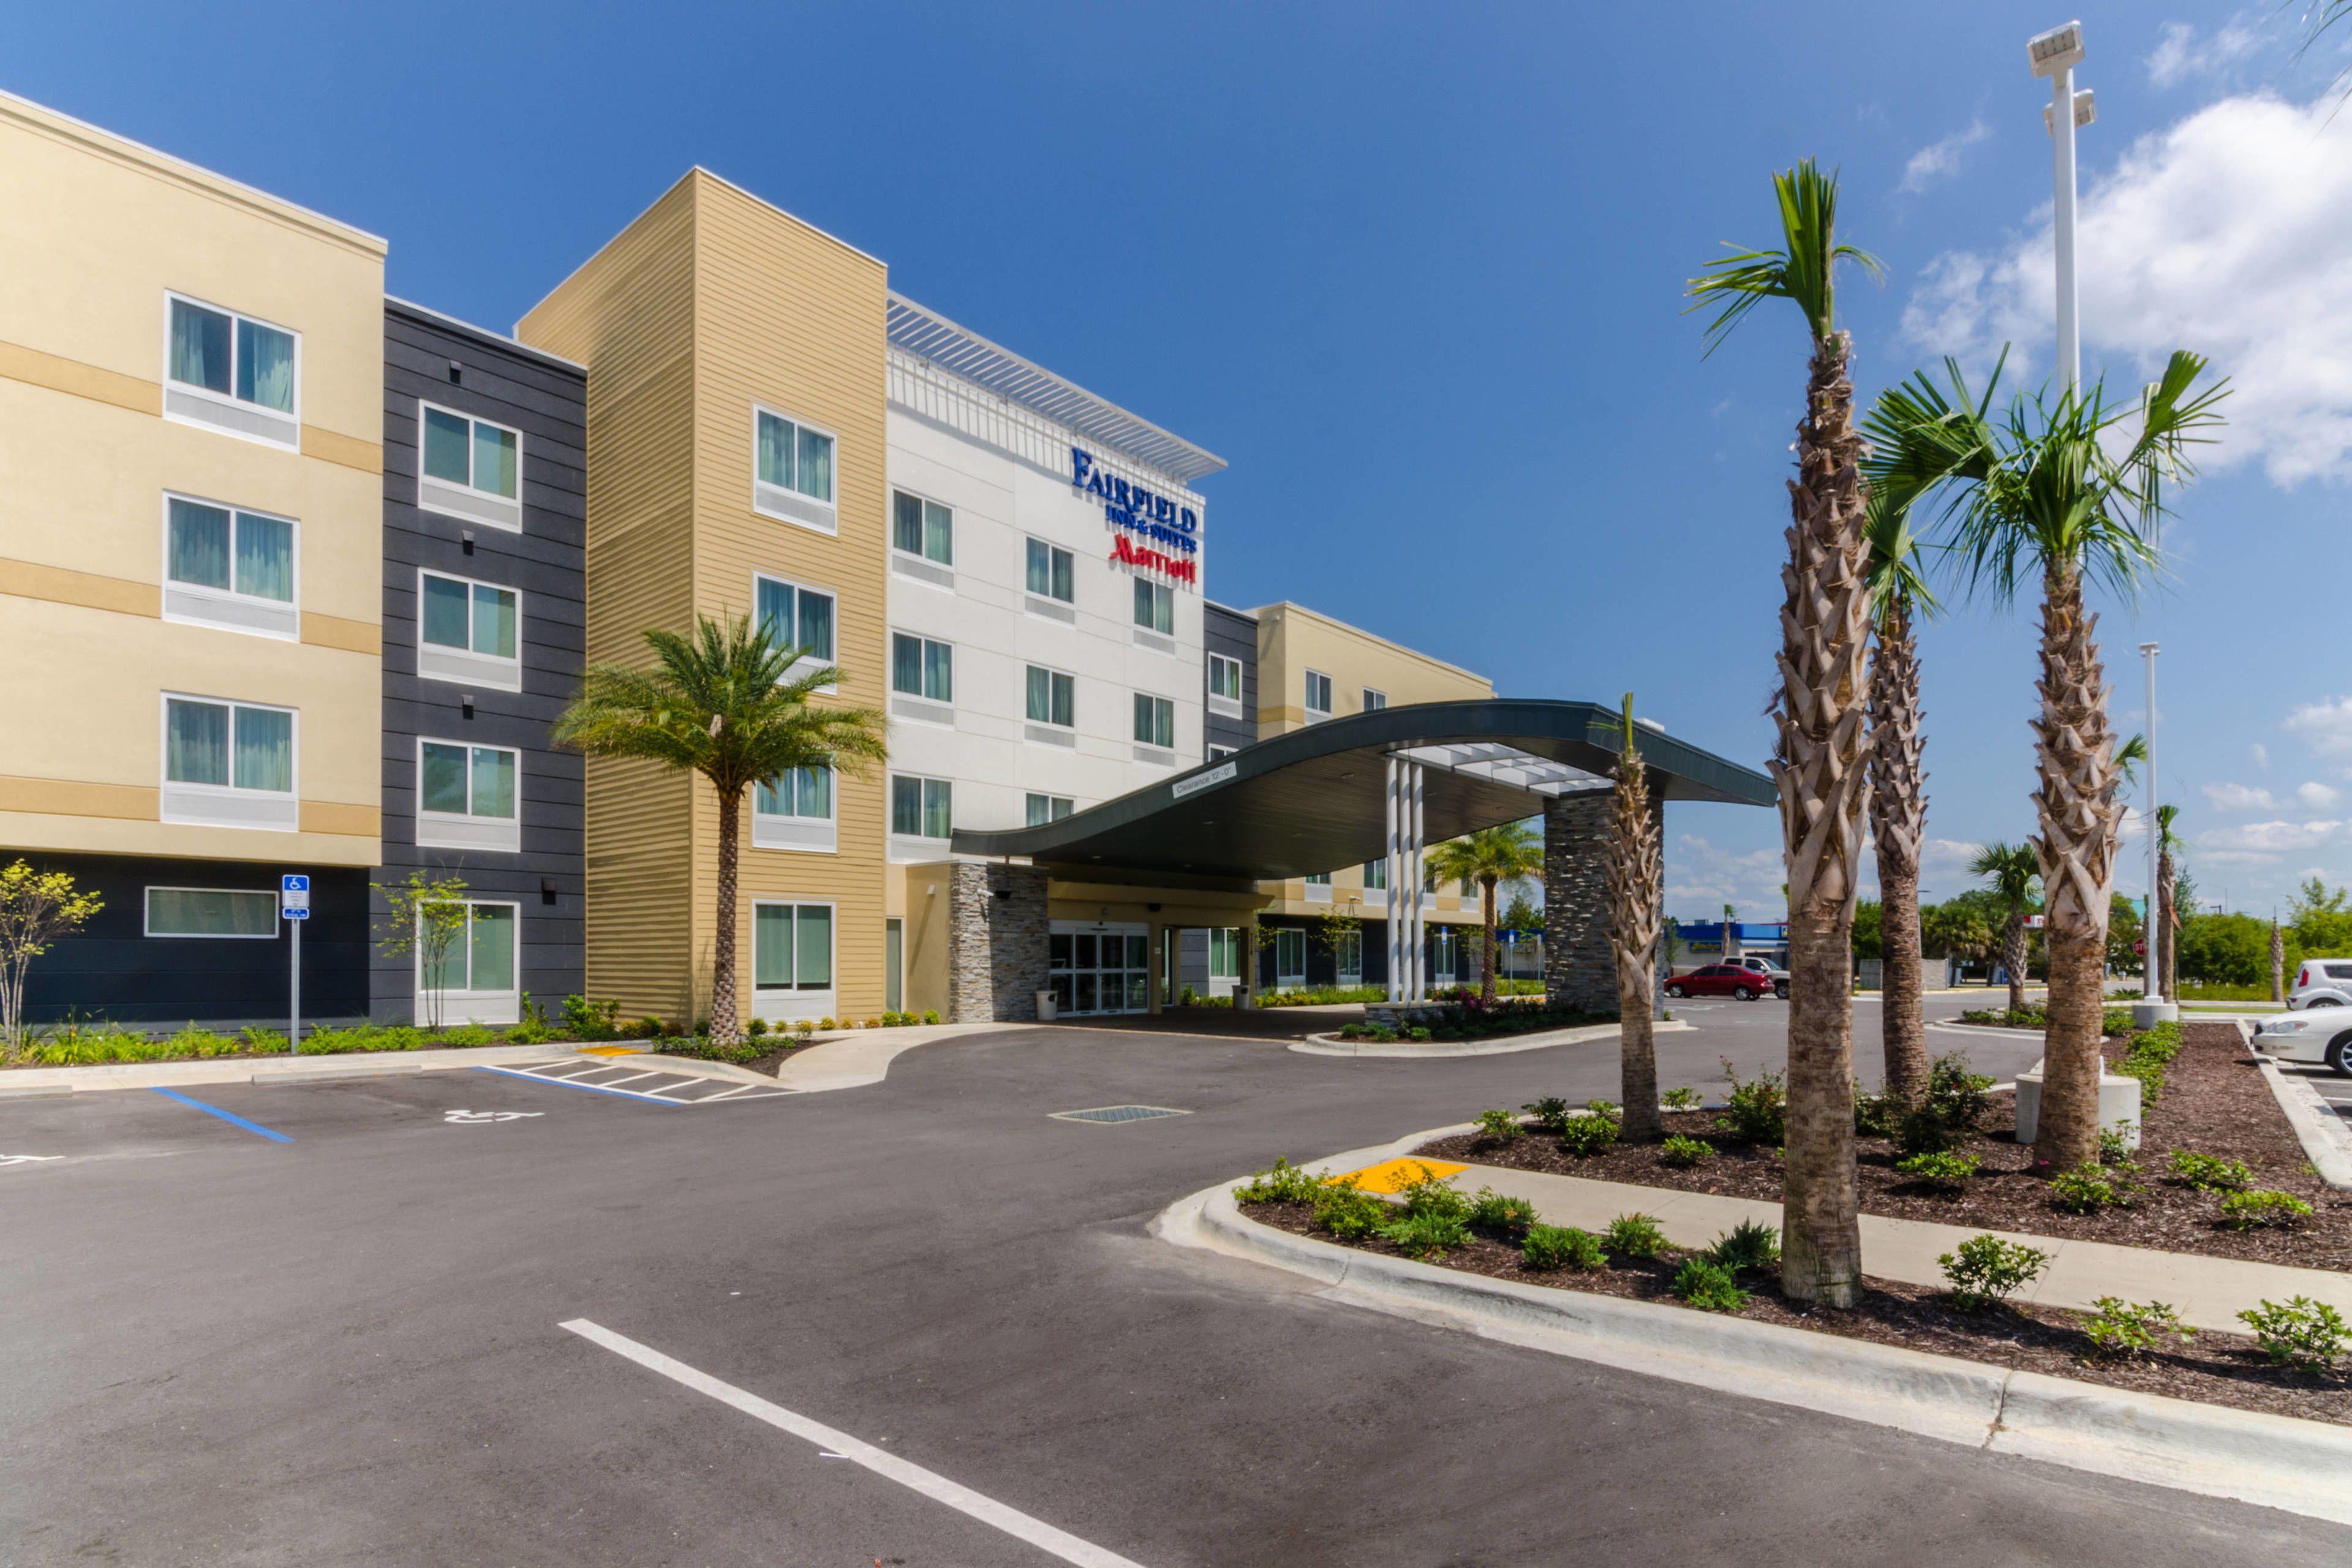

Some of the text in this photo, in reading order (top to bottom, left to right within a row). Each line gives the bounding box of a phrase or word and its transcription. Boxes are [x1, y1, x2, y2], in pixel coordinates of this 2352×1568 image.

[1072, 447, 1197, 533] FAIRFIELD
[1106, 504, 1197, 553] INN & SUITES
[1109, 533, 1197, 584] Marriott
